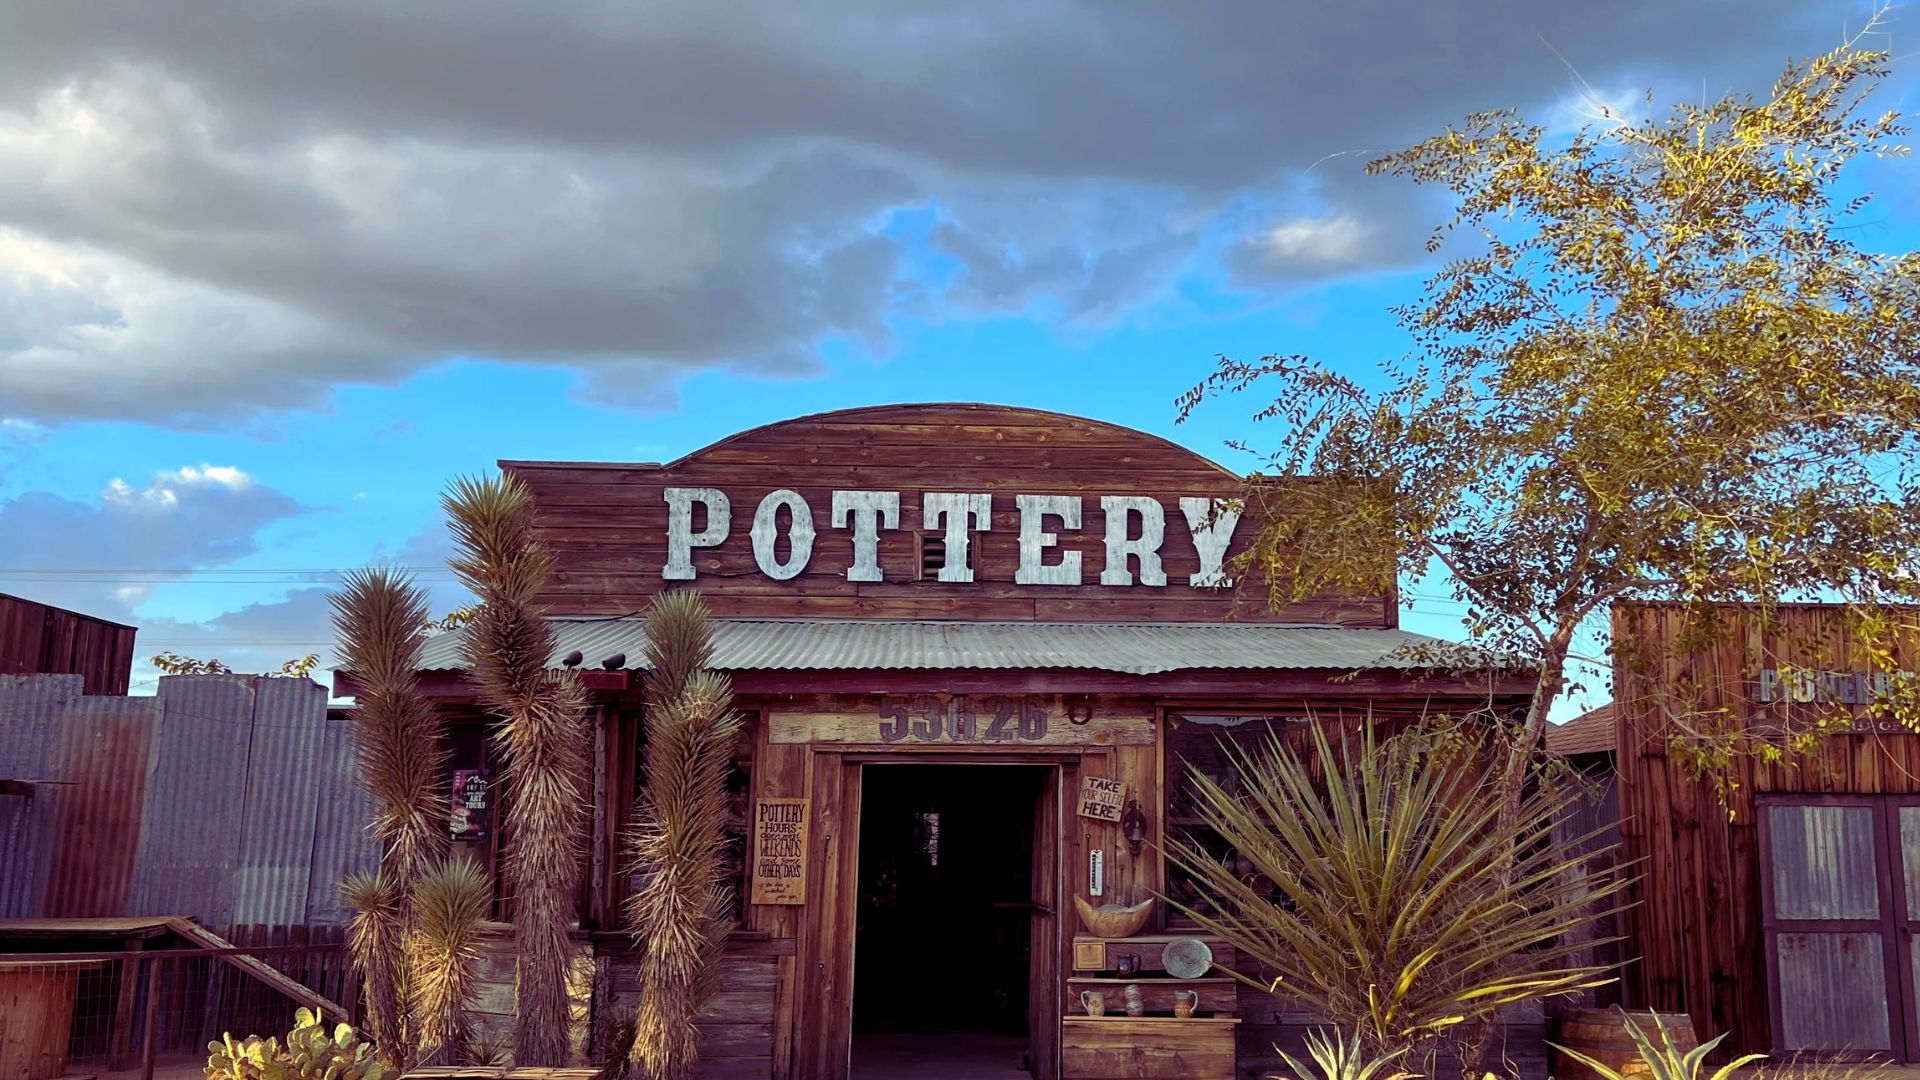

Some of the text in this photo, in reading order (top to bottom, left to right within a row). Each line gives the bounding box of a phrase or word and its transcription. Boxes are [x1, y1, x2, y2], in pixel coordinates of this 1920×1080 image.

[661, 487, 1245, 588] POTTERY
[879, 696, 1048, 741] 53626
[1089, 778, 1120, 793] TAKE
[760, 804, 805, 822] POTTERY
[1083, 801, 1116, 818] HERE
[760, 838, 801, 857] WEEKENDS
[758, 863, 802, 880] OTHER DAYS
